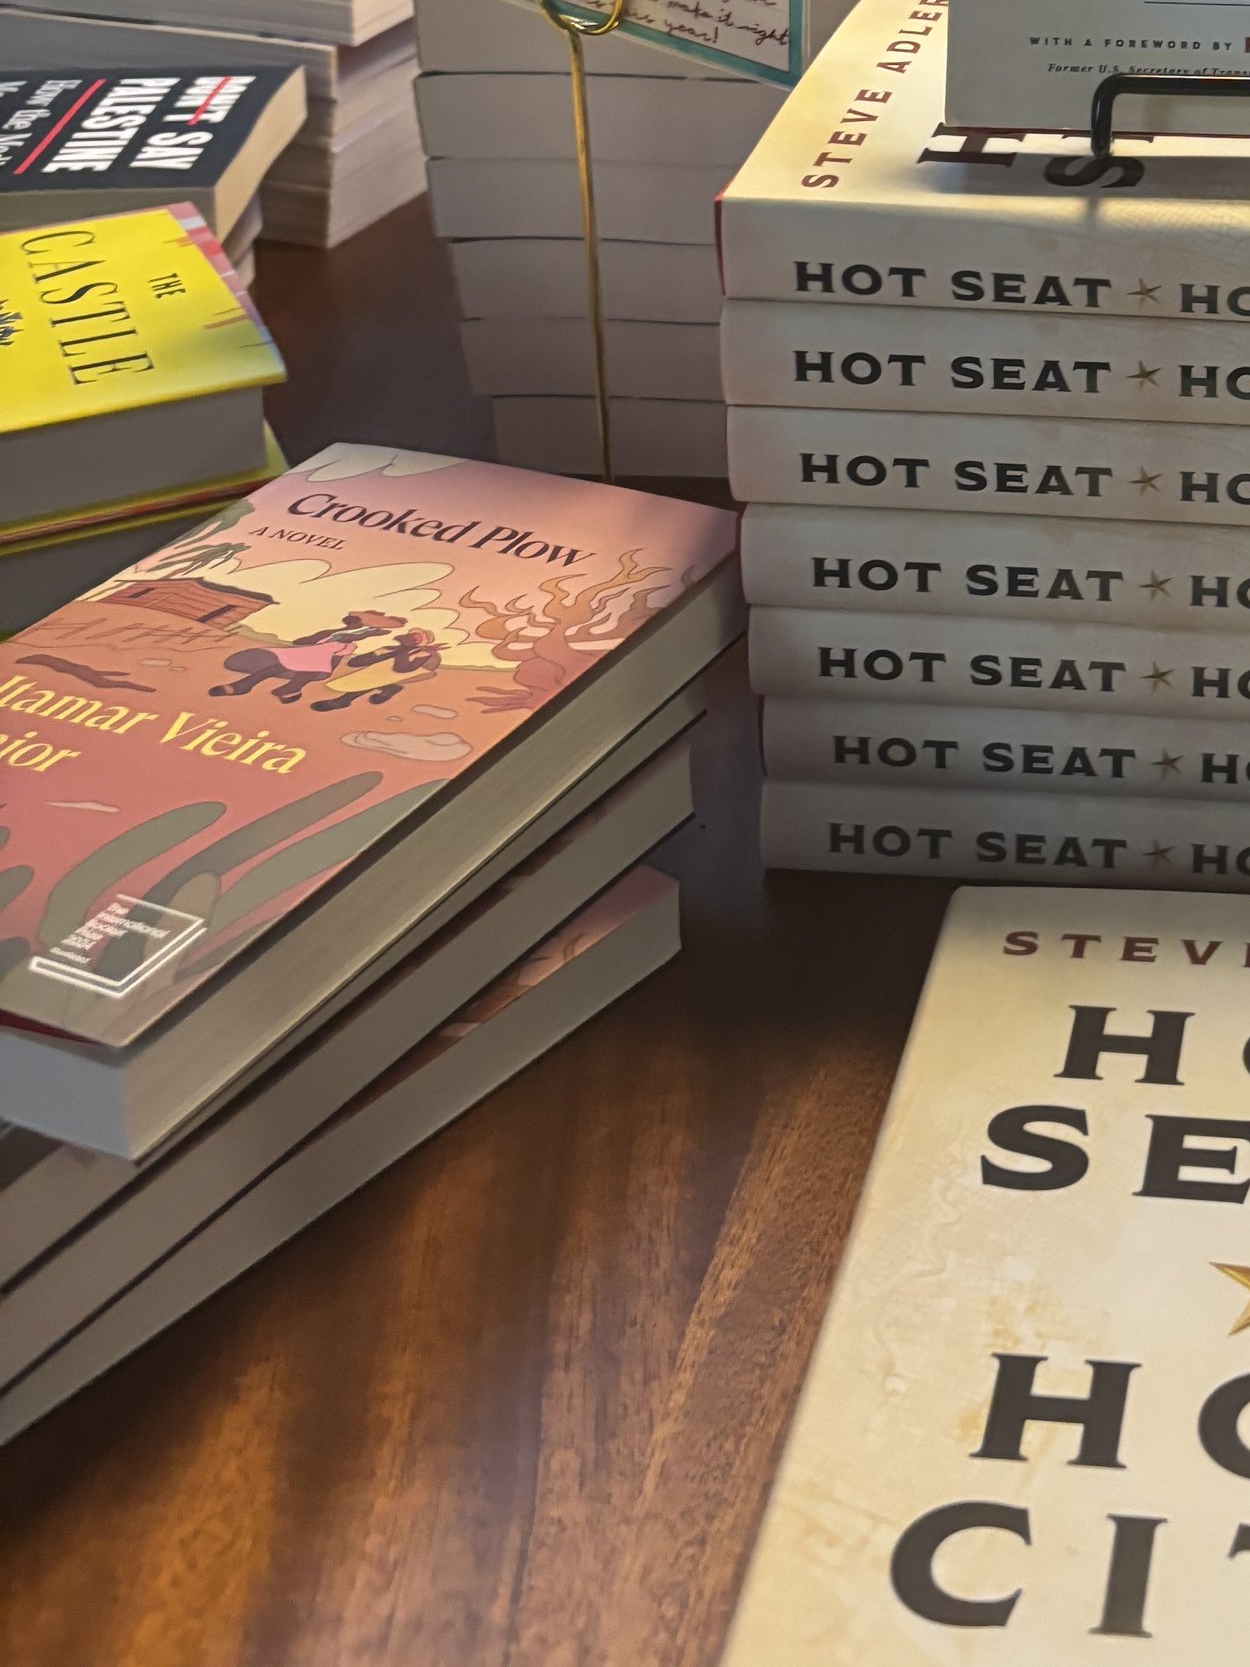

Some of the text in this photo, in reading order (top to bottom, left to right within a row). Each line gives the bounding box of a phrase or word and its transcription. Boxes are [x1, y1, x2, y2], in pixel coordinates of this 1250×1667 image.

[1030, 37, 1073, 47] WITH
[1084, 38, 1093, 47] A
[1104, 39, 1201, 50] FOREWORD
[1212, 41, 1232, 51] BY
[1048, 63, 1094, 74] Former
[25, 79, 83, 106] How
[1, 108, 52, 130] the
[41, 77, 182, 173] PALESTINE
[801, 89, 893, 189] STEVE
[129, 131, 214, 170] SAY
[147, 272, 187, 300] THE
[793, 261, 926, 298] HOT
[951, 270, 1112, 308] SEAT
[20, 230, 155, 385] CASTLE
[793, 350, 926, 386] HOT
[950, 356, 1112, 393] SEAT
[799, 453, 930, 488] HOT
[954, 460, 1113, 497] SEAT
[249, 526, 347, 551] A NOVEL
[287, 493, 597, 568] Crooked Plow
[811, 557, 942, 593] HOT
[965, 564, 1124, 601] SEAT
[818, 646, 946, 682] HOT
[969, 654, 1126, 692] SEAT
[159, 711, 307, 774] Vieira
[832, 735, 959, 769] HOT
[982, 742, 1136, 778] SEAT
[828, 822, 953, 859] HOT
[975, 831, 1128, 869] SEAT
